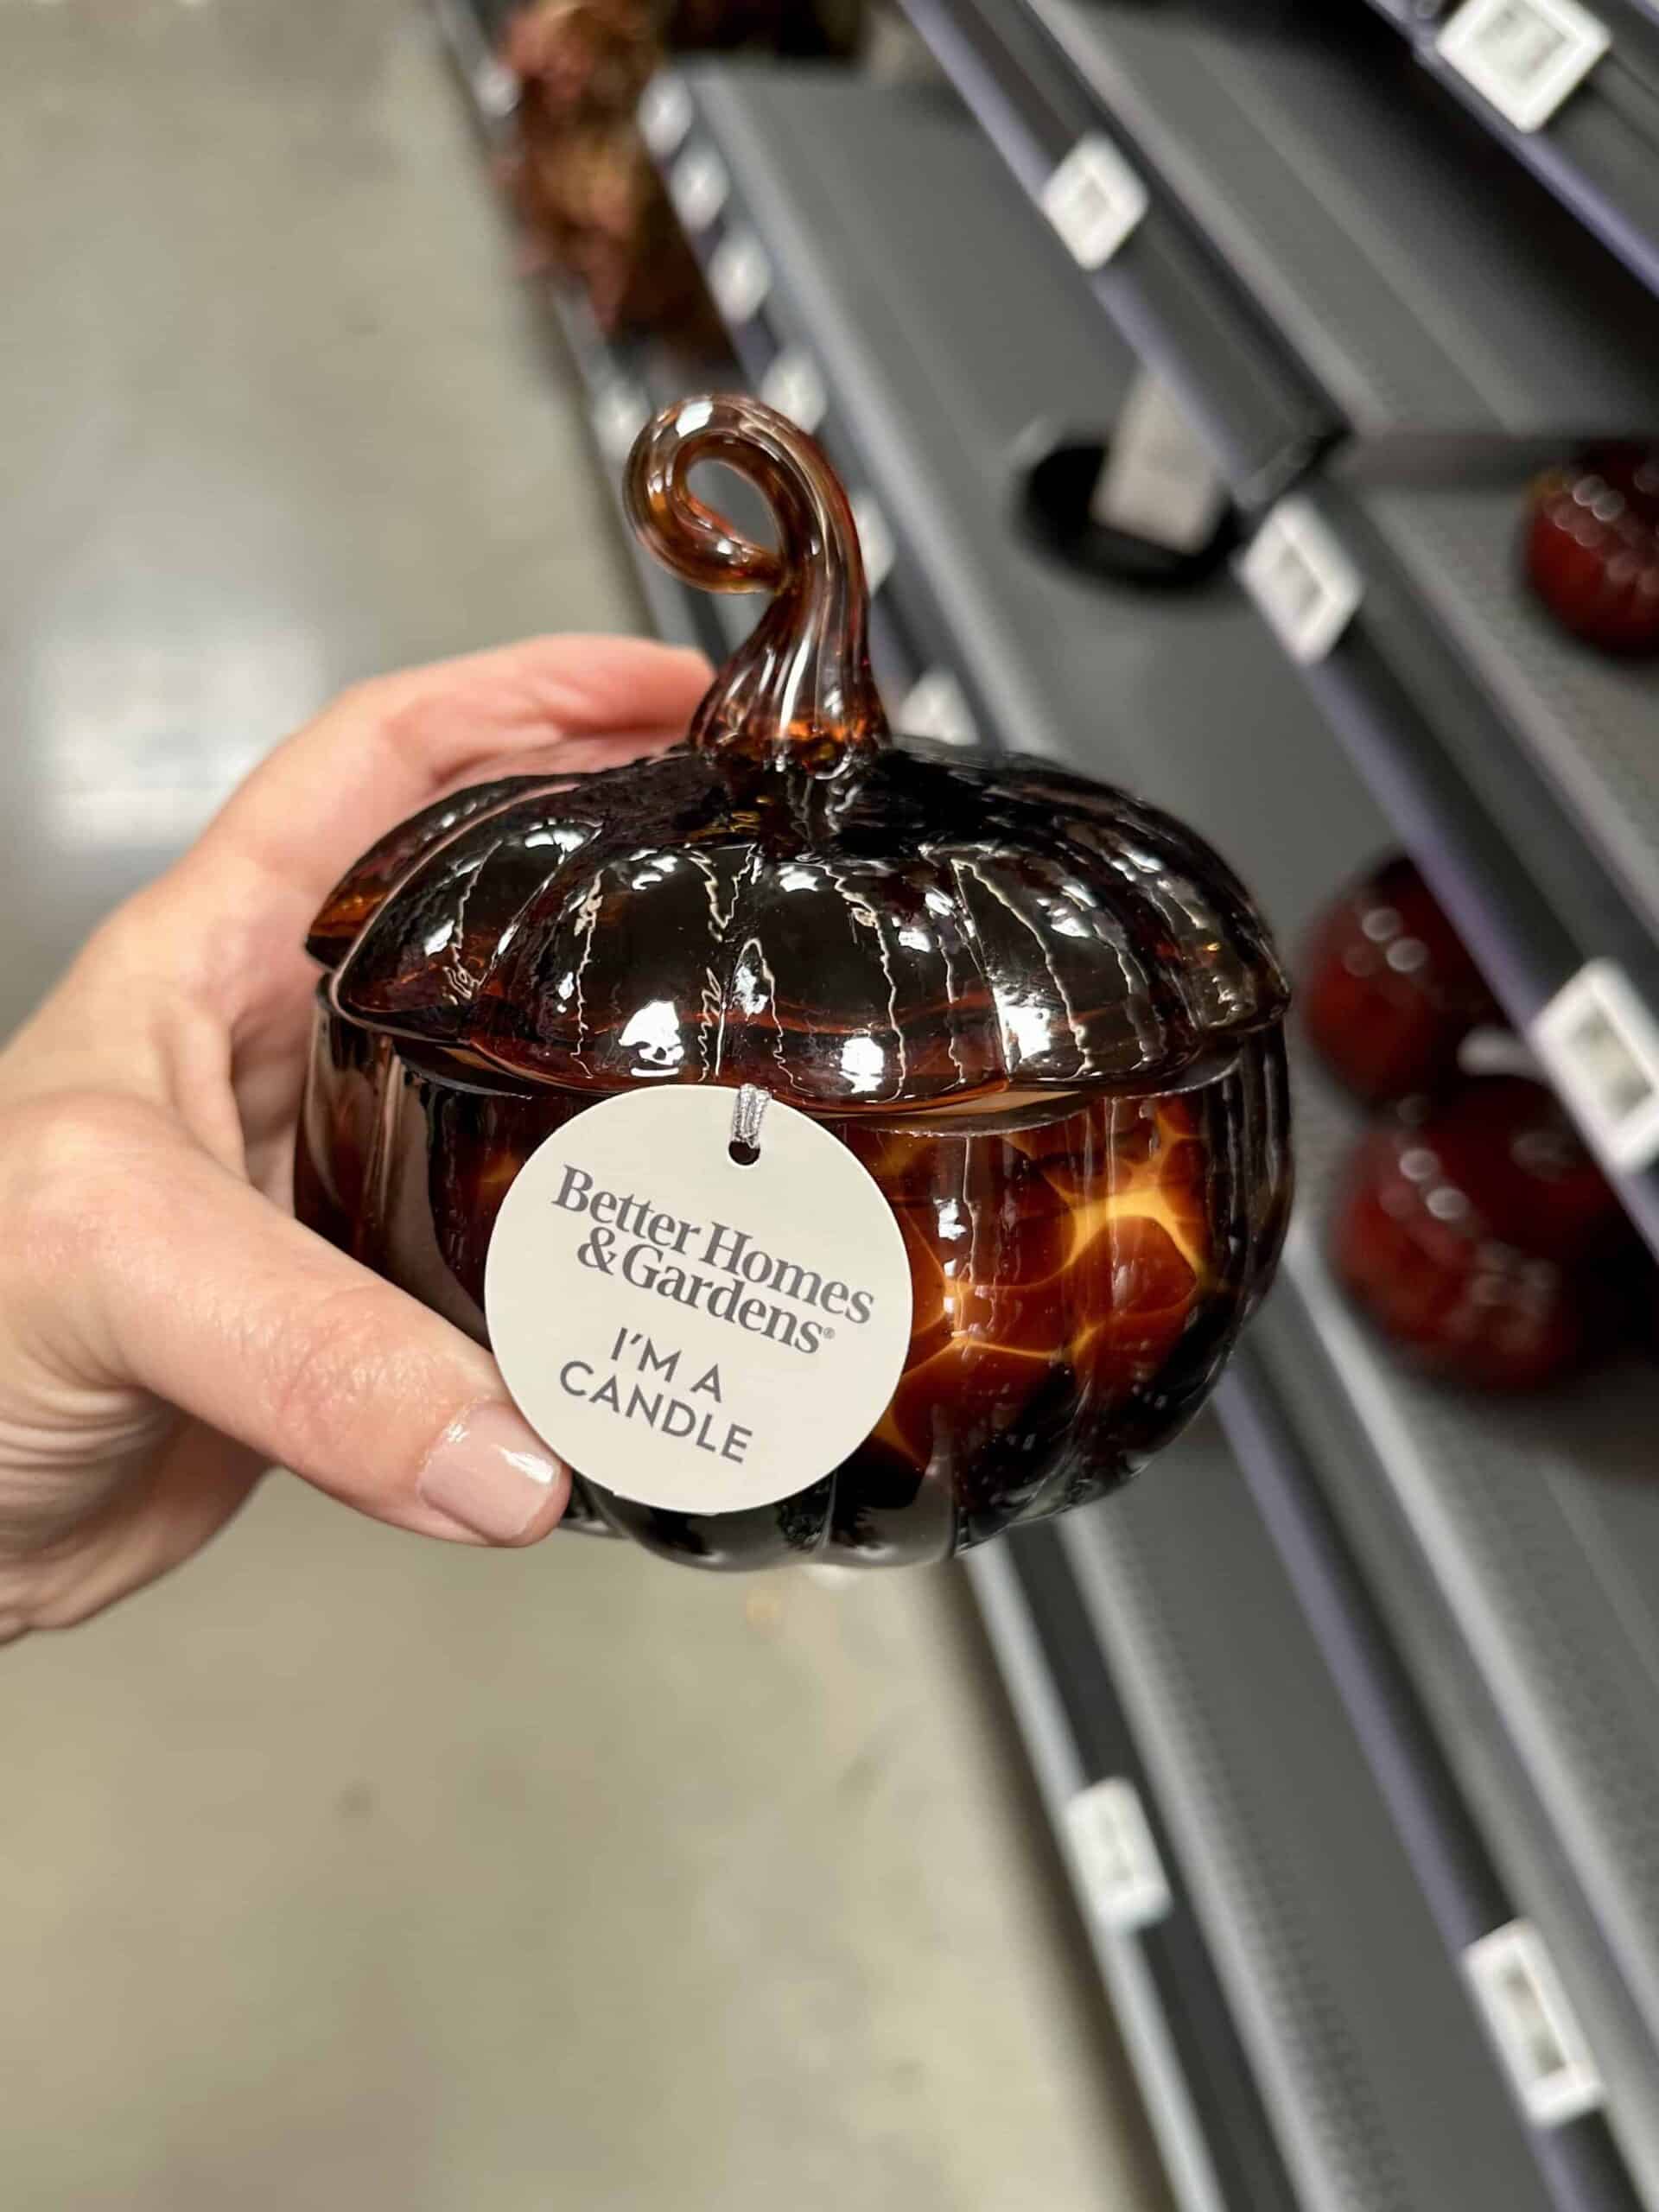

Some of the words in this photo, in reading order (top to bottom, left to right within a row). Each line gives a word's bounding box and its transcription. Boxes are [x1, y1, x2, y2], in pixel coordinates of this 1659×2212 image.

[551, 1165, 700, 1255] Better
[699, 1222, 874, 1324] Homes
[560, 1361, 753, 1464] CANDLE
[611, 1327, 682, 1382] I'M
[690, 1364, 722, 1403] A
